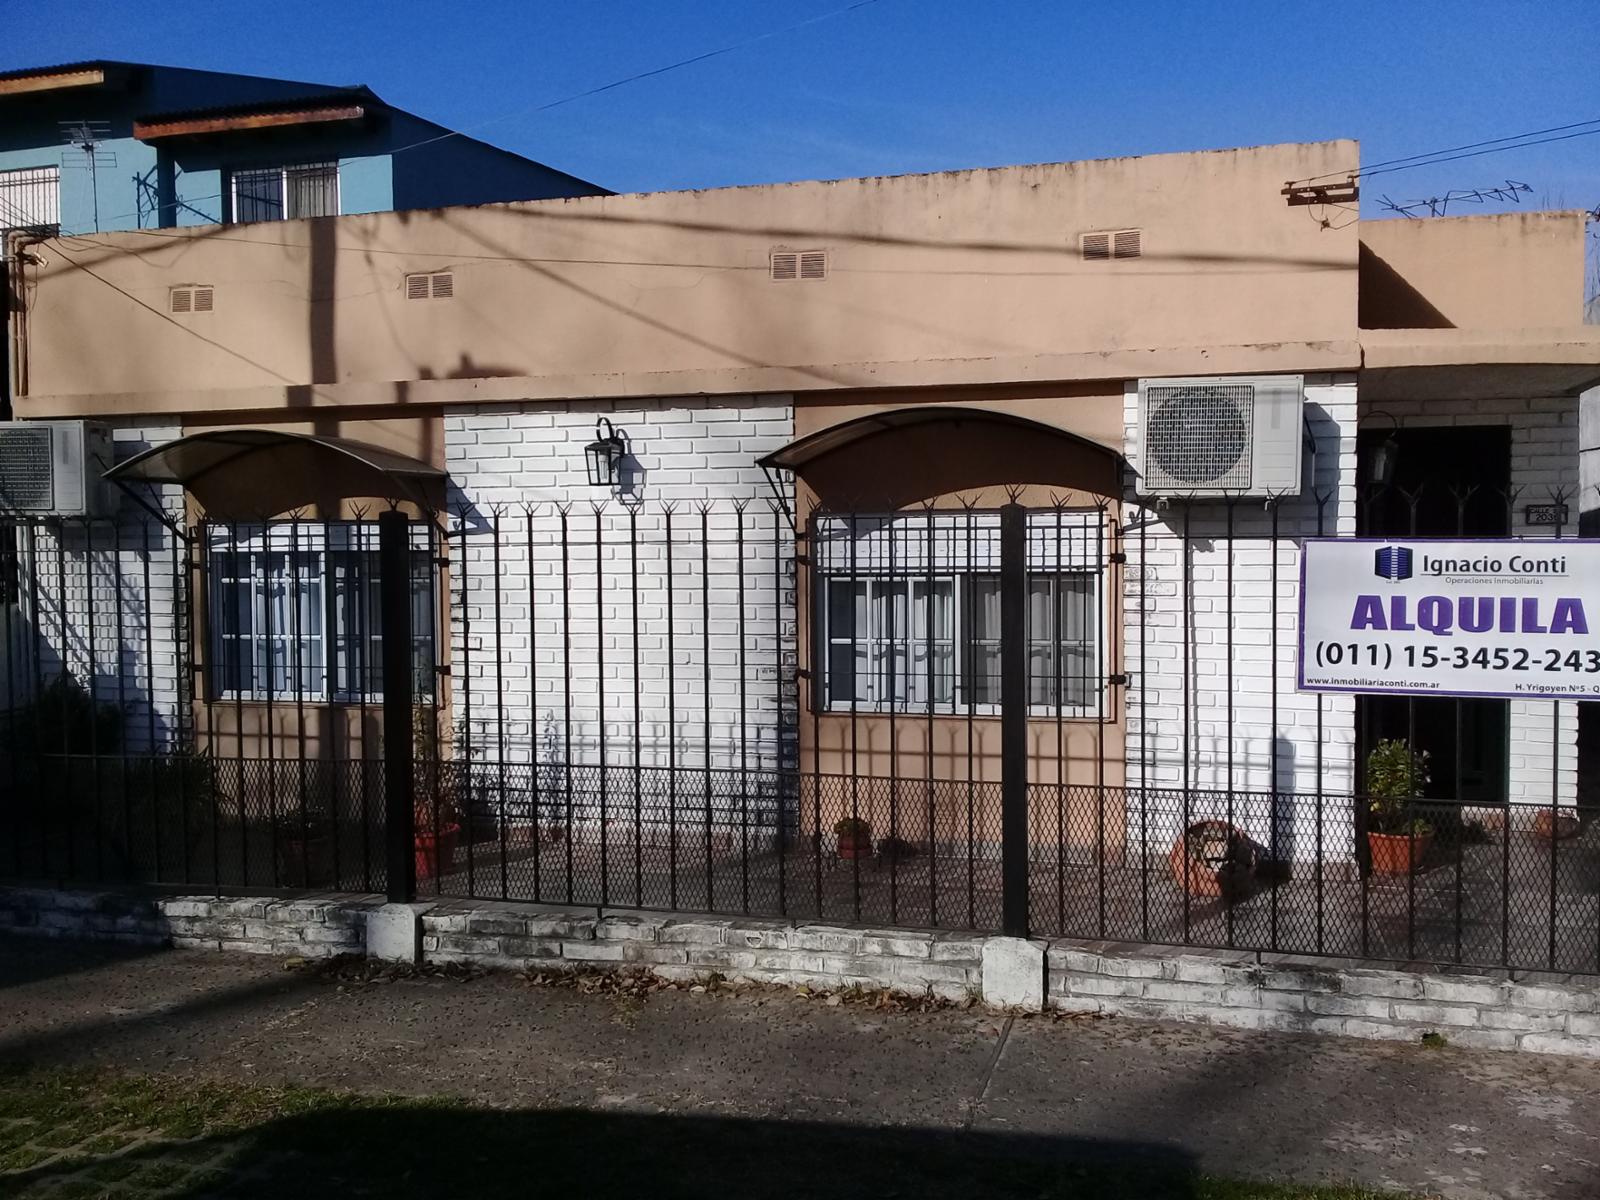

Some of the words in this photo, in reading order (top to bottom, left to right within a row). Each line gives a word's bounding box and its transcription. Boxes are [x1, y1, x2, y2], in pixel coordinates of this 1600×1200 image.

[1424, 555, 1502, 576] Ignacio
[1510, 556, 1567, 573] Conti
[1445, 577, 1493, 585] Operaciones
[1350, 595, 1590, 636] ALQUILA
[1316, 641, 1392, 670] (011)
[1404, 645, 1600, 673] 15-3452-243
[1306, 677, 1441, 689] www.inmobiliariaconti.com.ar
[1527, 683, 1567, 693] Yrigoyen
